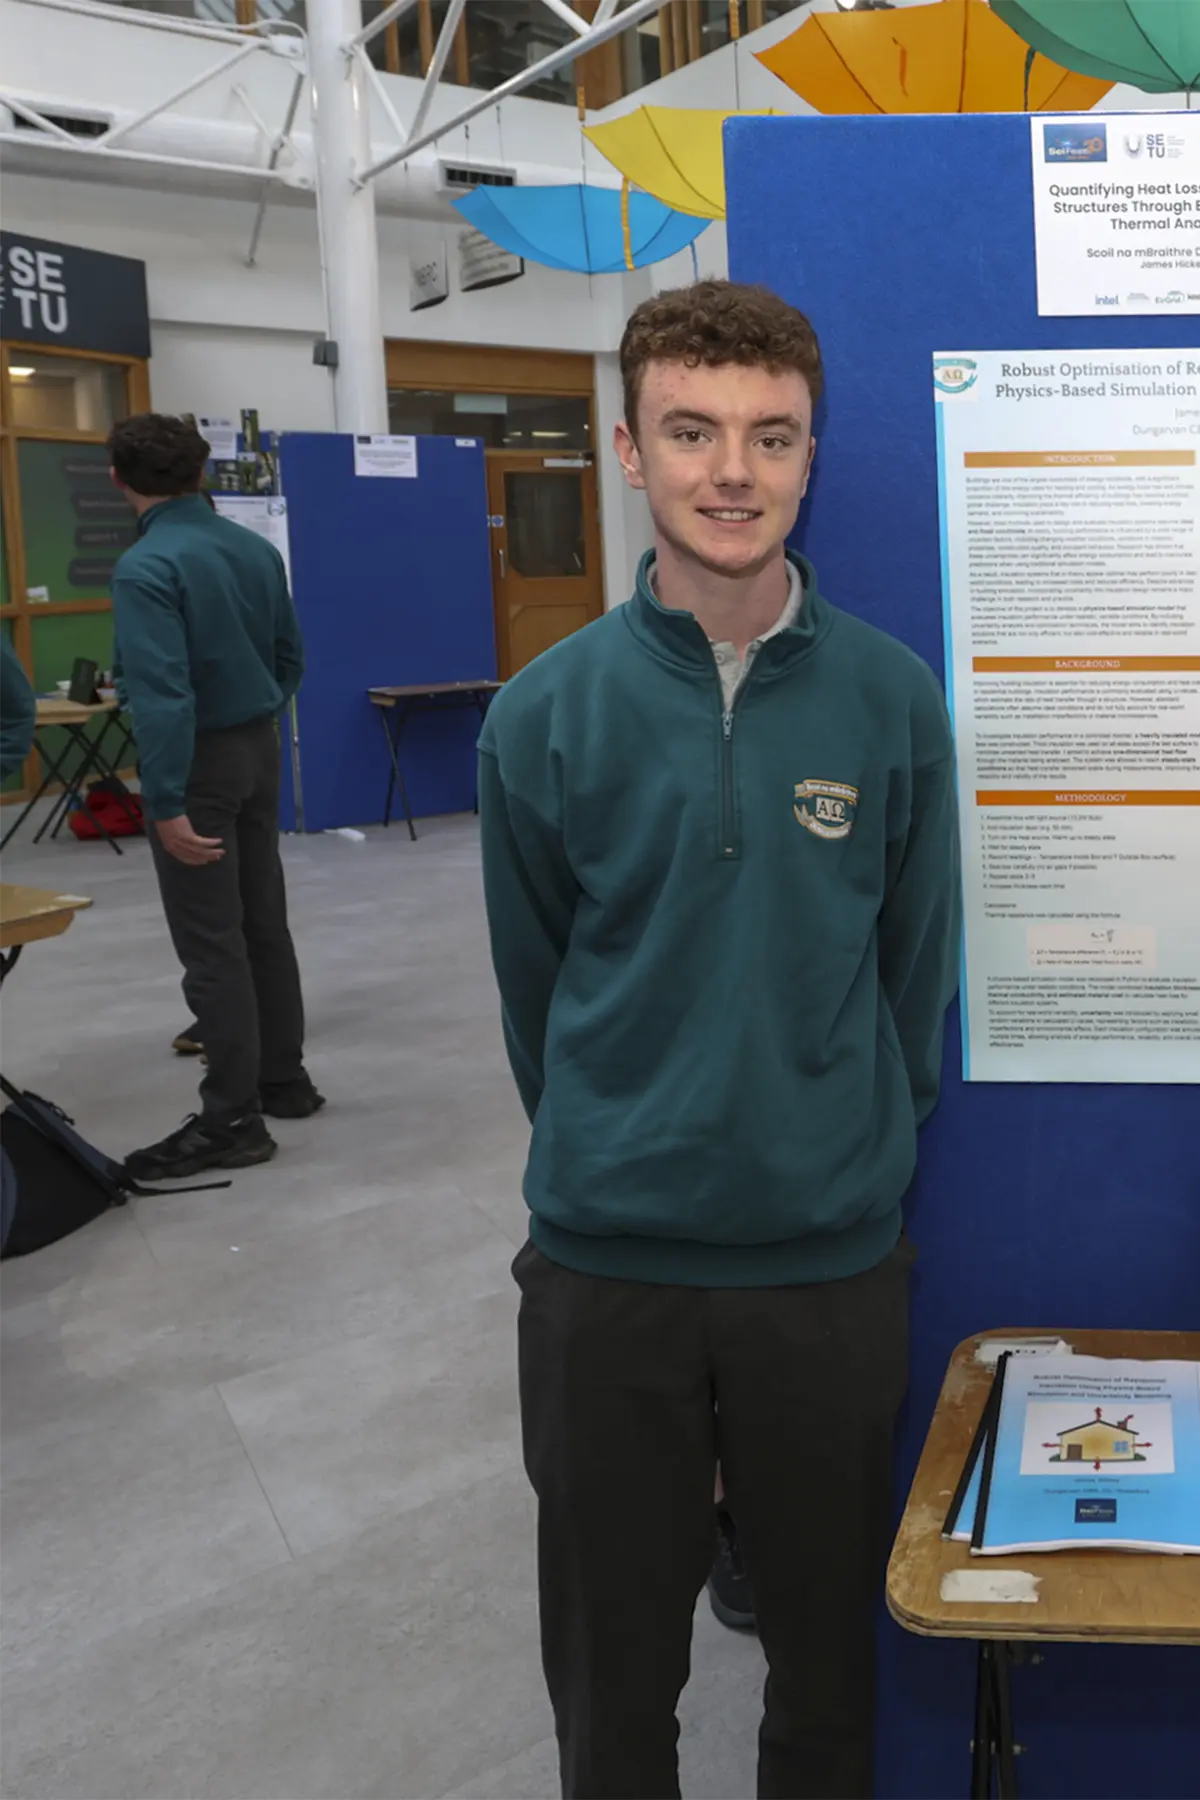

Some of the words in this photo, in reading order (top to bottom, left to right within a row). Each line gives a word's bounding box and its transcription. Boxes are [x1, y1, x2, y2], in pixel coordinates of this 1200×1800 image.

[1146, 134, 1164, 146] SE
[1147, 147, 1165, 158] TU
[1049, 184, 1134, 199] Quantifying
[1138, 183, 1171, 195] Heat
[1053, 201, 1128, 213] Structures
[1131, 200, 1192, 216] Through
[1110, 217, 1170, 230] Thermal
[1086, 247, 1114, 258] Scoil
[1117, 249, 1132, 258] na
[1134, 246, 1193, 257] mBraithre
[8, 245, 67, 294] SE
[1140, 260, 1172, 269] James
[11, 287, 69, 334] TU
[1001, 363, 1055, 377] Robust
[1059, 361, 1162, 380] Optimisation
[1166, 360, 1183, 375] of
[995, 383, 1106, 402] Physics-Based
[1109, 381, 1197, 397] Simulation
[1132, 423, 1187, 437] Dungarvan
[1055, 659, 1121, 669] BACKGROUND
[1055, 793, 1127, 803] METHODOLOGY
